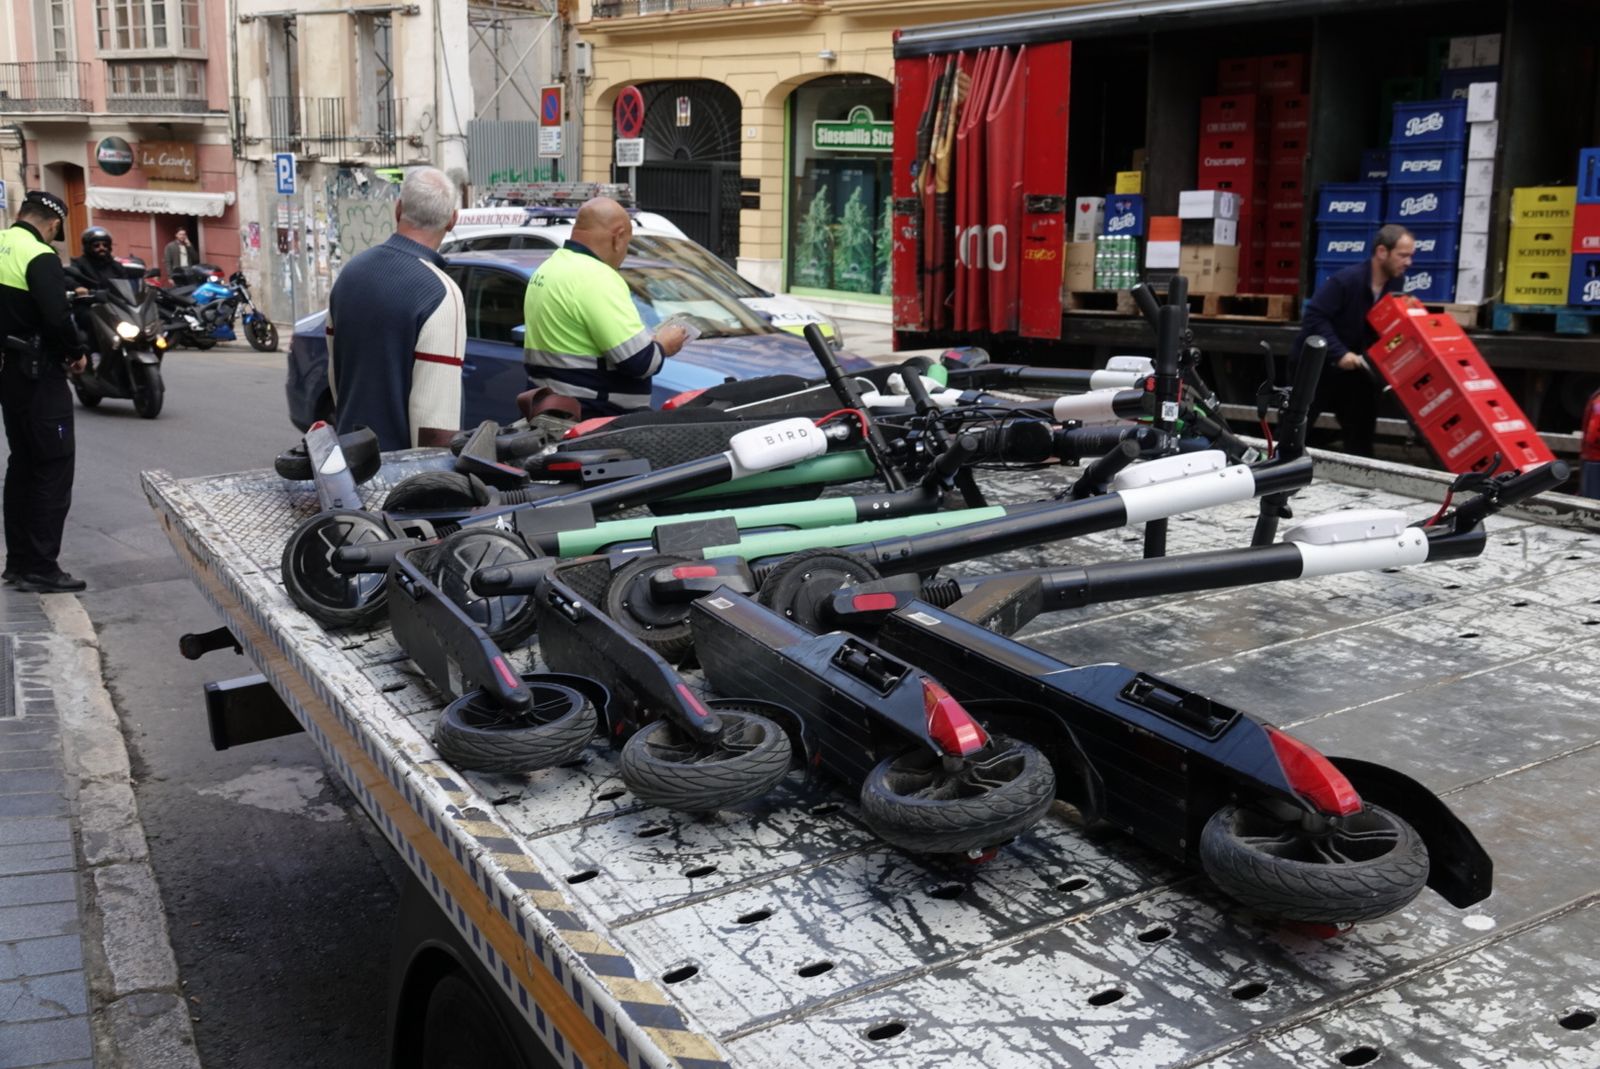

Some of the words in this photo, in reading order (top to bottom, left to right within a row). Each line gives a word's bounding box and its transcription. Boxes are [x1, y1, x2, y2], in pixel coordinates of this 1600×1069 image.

[817, 127, 871, 145] Sinsemilla
[872, 128, 894, 146] Stre
[143, 151, 155, 165] La
[1204, 157, 1246, 167] Cruzcampo
[1401, 160, 1443, 172] PEPSI
[1328, 201, 1367, 213] PEPSI
[1521, 209, 1571, 219] SCHWEPPES
[1327, 241, 1366, 253] PEPSI
[1412, 239, 1437, 252] PSI
[1517, 248, 1567, 258] SCHWEPPES
[1514, 285, 1564, 296] SCHWEPPES
[763, 428, 808, 446] BIRD
